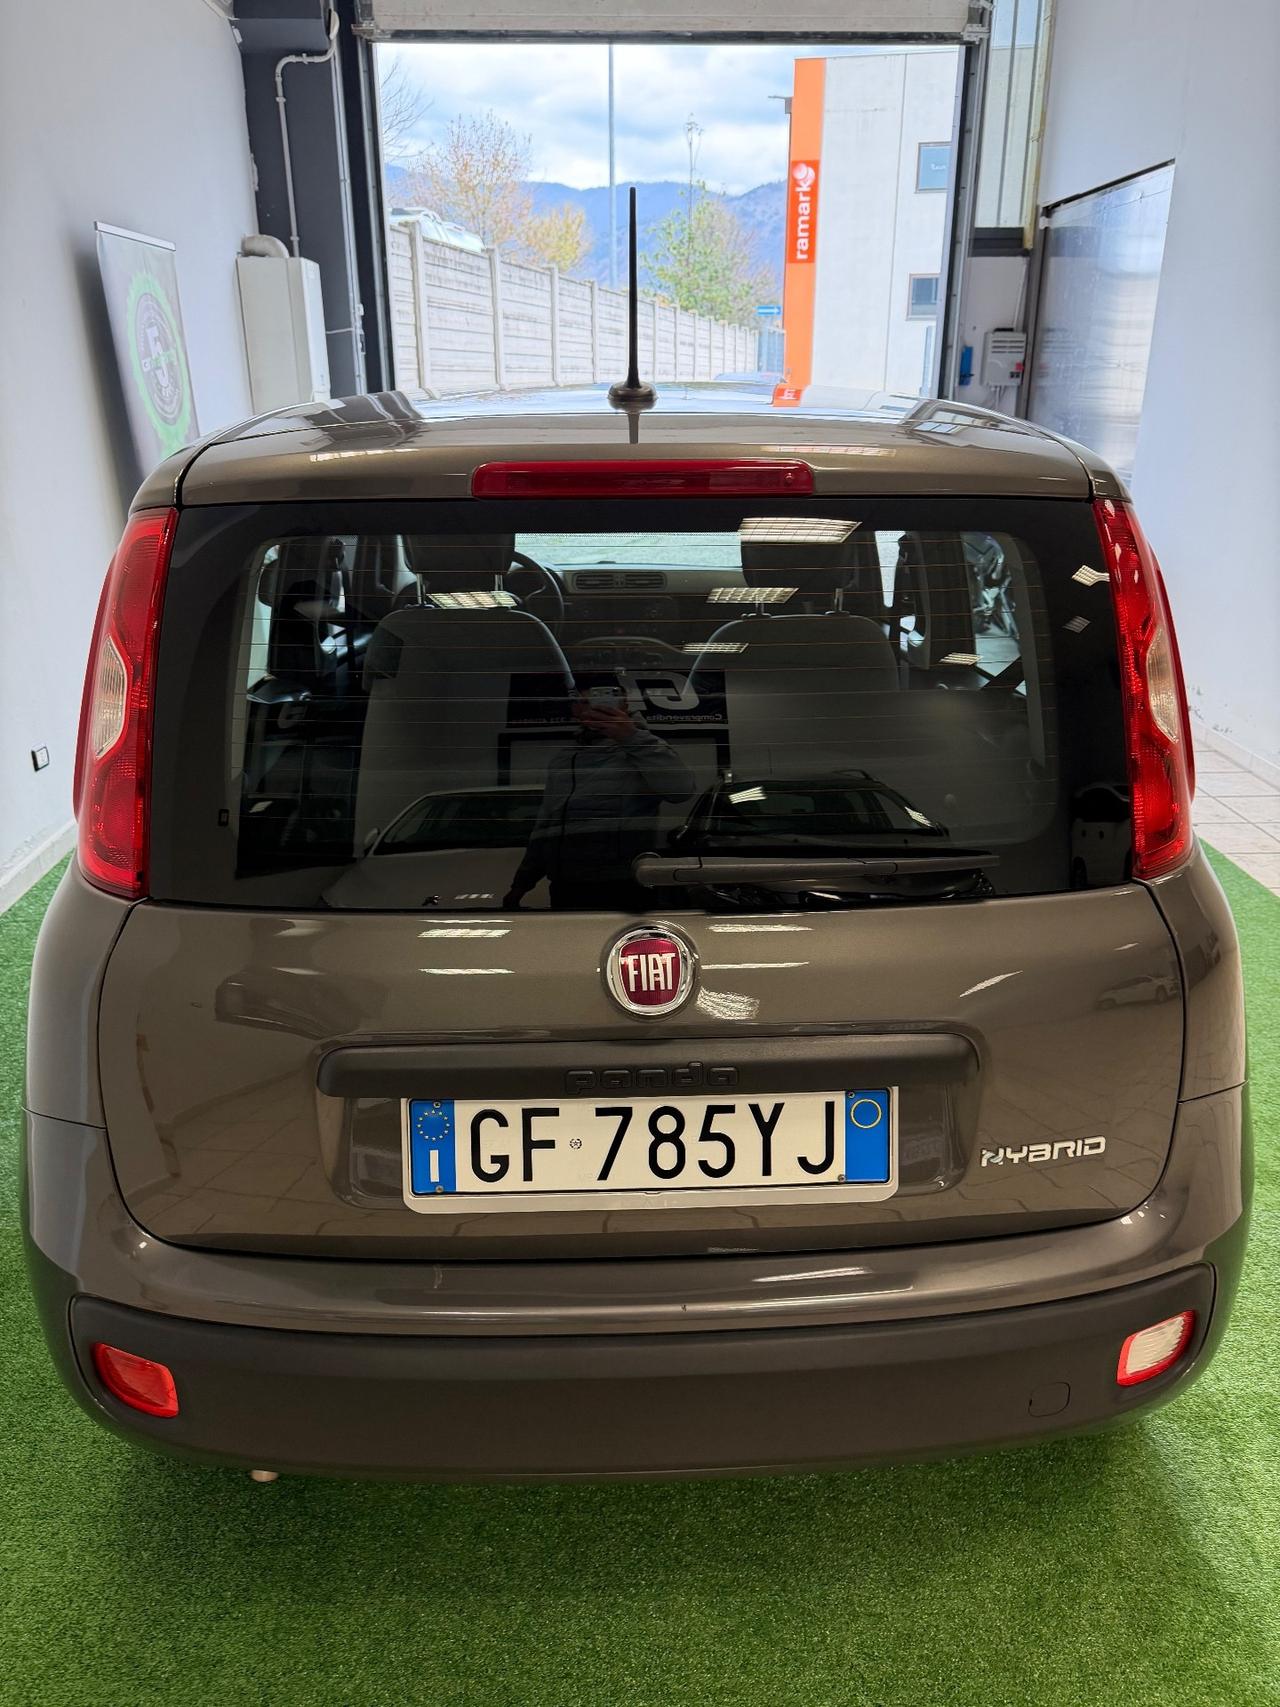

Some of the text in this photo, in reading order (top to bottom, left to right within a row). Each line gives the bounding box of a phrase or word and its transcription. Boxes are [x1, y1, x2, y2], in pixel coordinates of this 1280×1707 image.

[627, 952, 676, 992] FIAT
[565, 1061, 740, 1095] panda
[470, 1100, 836, 1183] GF 785YJ
[980, 1135, 1107, 1167] HYBRID
